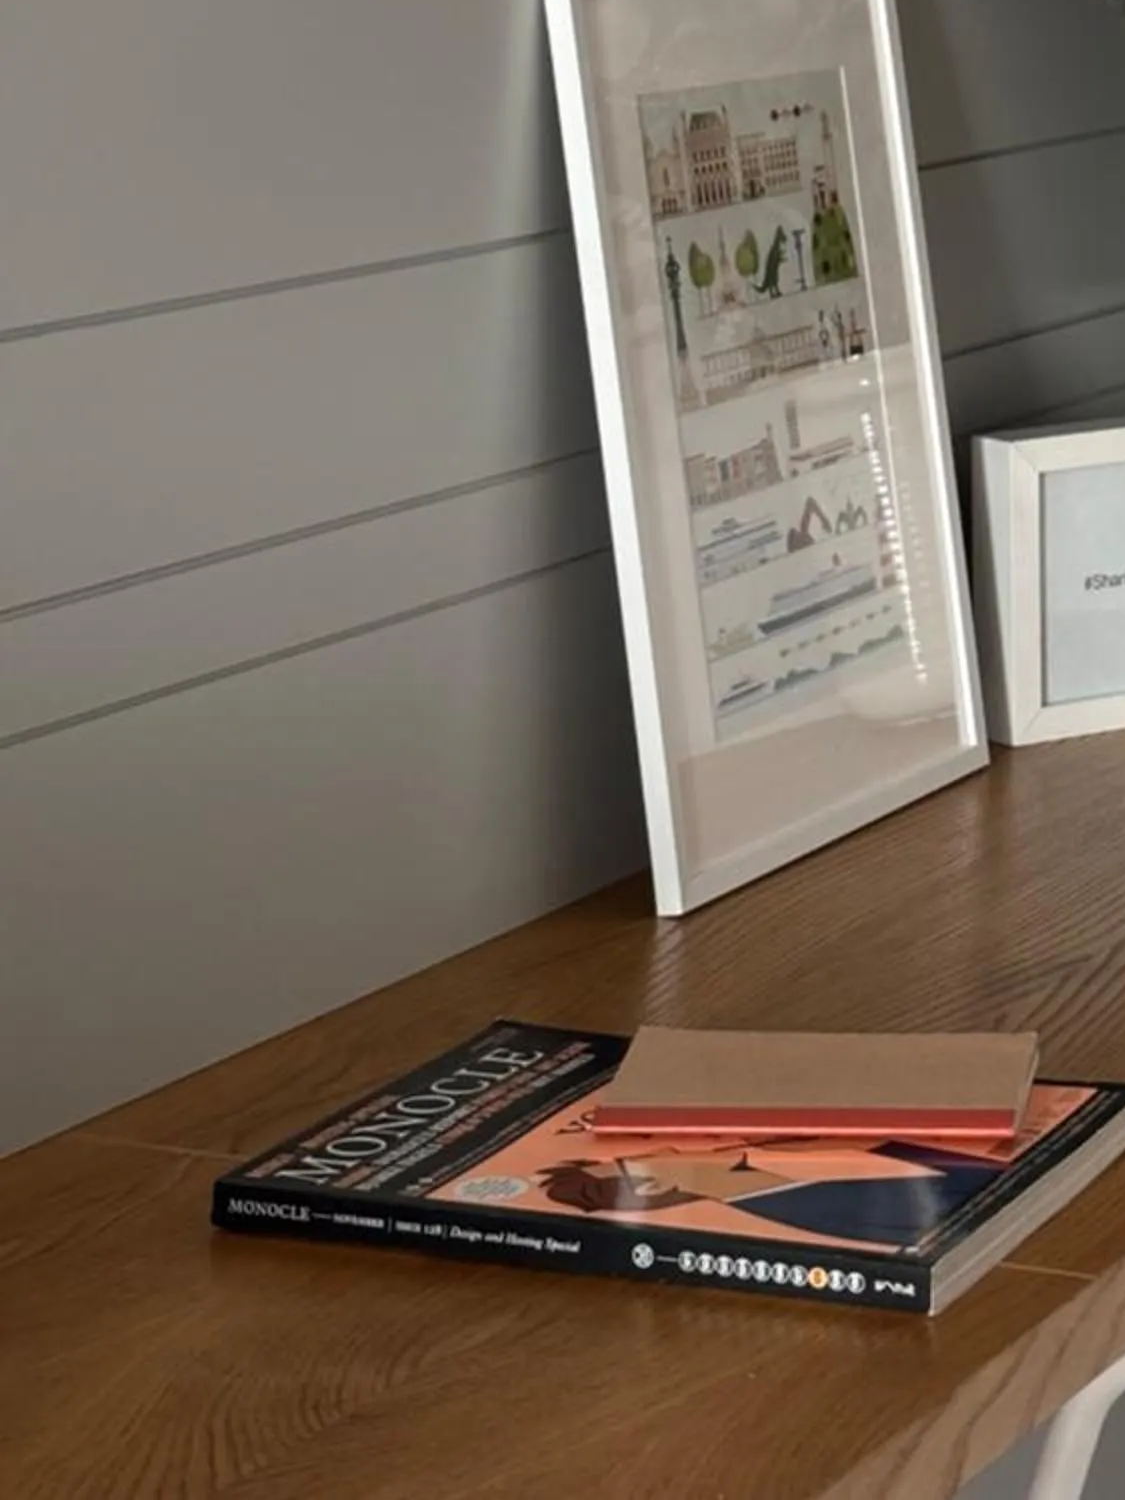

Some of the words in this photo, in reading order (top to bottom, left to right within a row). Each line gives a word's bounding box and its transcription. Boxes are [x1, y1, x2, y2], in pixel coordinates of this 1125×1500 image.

[275, 1046, 544, 1185] MONOCLE
[227, 1198, 311, 1222] MONOCLE
[449, 1225, 482, 1243] Design
[484, 1231, 504, 1243] and
